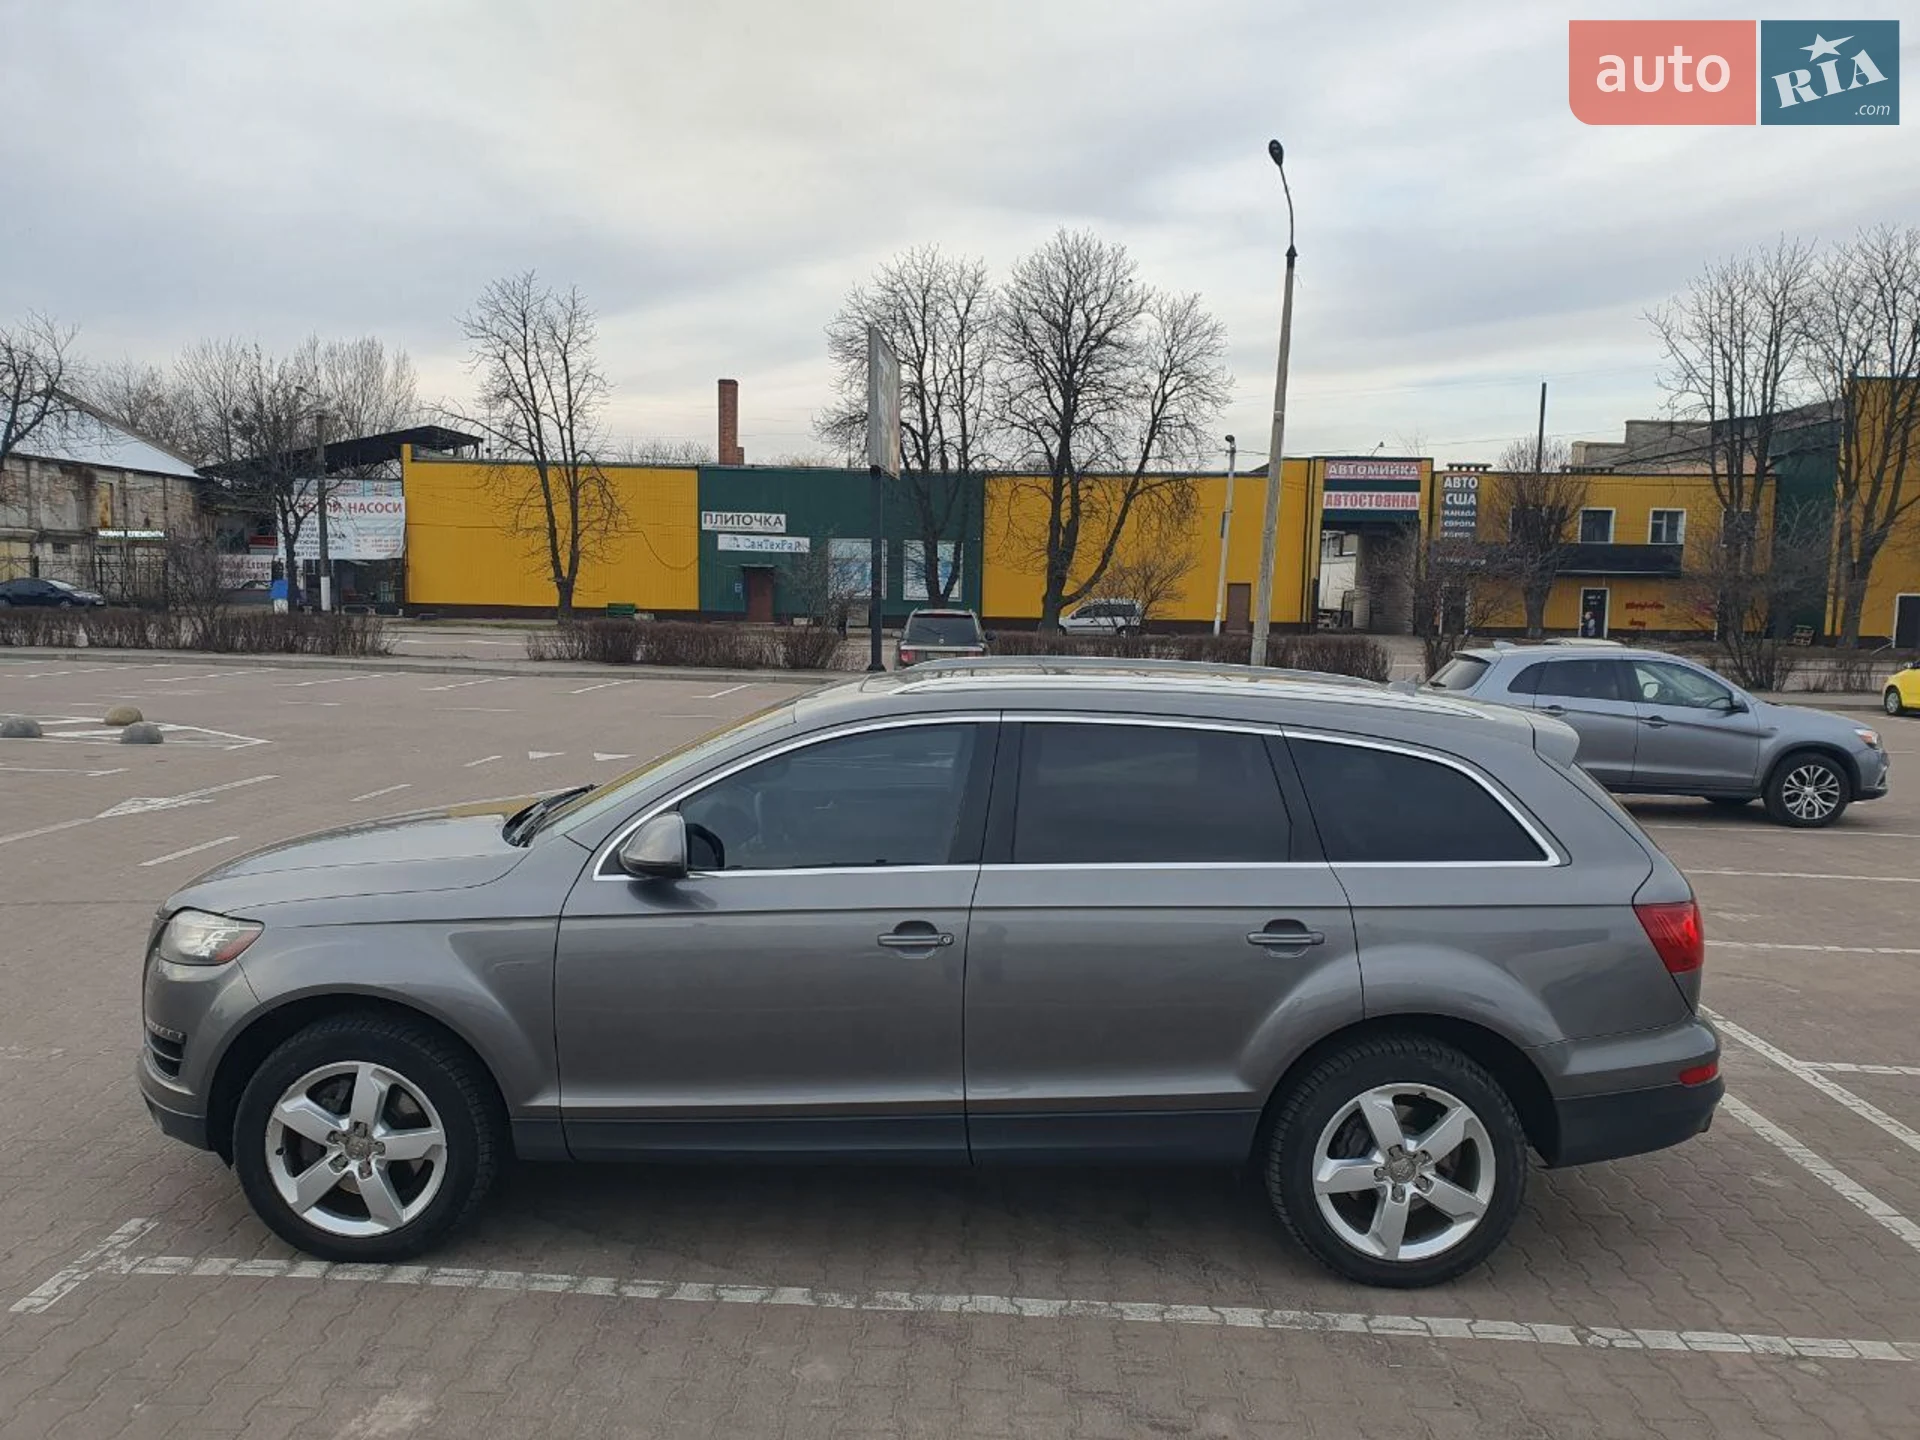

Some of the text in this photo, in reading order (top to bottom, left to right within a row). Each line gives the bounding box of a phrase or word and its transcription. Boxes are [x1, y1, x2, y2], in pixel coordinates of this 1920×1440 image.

[1328, 463, 1418, 475] АВТОМИЙКА
[1443, 476, 1478, 489] АВТО
[1325, 493, 1417, 508] АВТОСТОЯНКА
[1445, 493, 1477, 505] США
[348, 502, 402, 514] НАСОСИ
[703, 513, 783, 526] ПЛИТОЧКА
